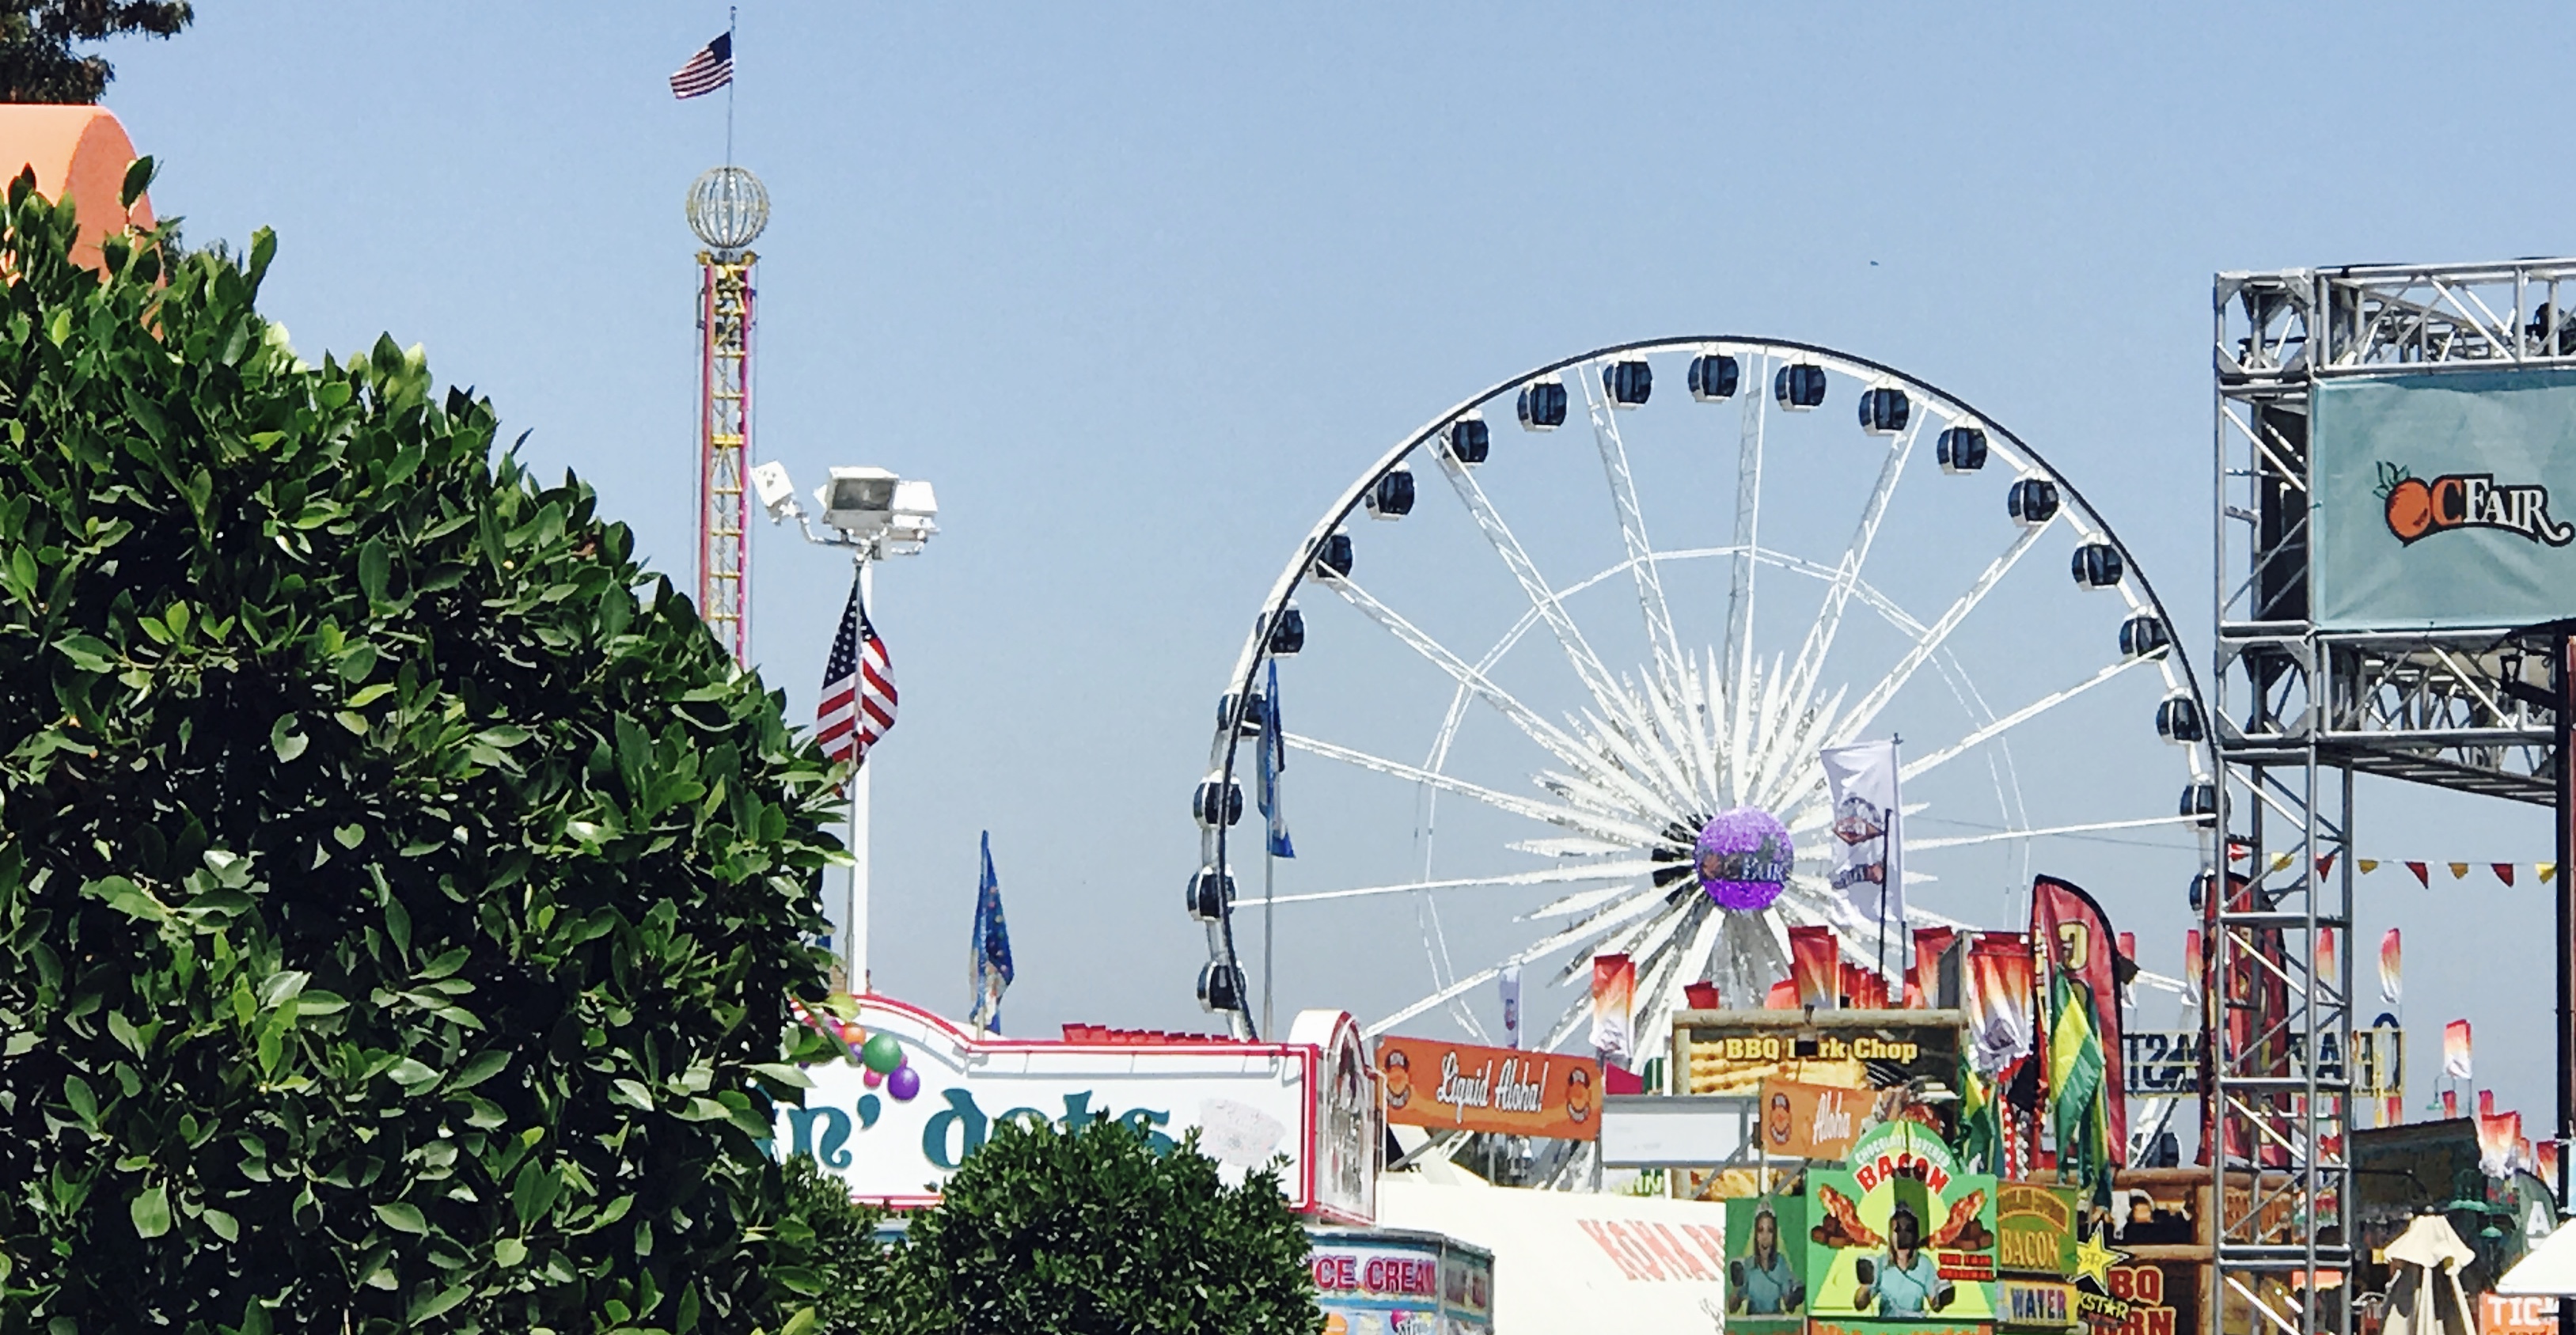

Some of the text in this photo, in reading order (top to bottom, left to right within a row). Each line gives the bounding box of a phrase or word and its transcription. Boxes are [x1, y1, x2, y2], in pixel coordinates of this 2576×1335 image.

[1725, 1037, 1780, 1060] BBQ
[1853, 1037, 1918, 1064] Chop
[1436, 1051, 1549, 1124] Liquid Aloha!
[1813, 1090, 1852, 1145] Aloha
[1855, 1151, 1952, 1196] BACON
[2001, 1228, 2060, 1268] BACON
[2011, 1287, 2066, 1320] WATER
